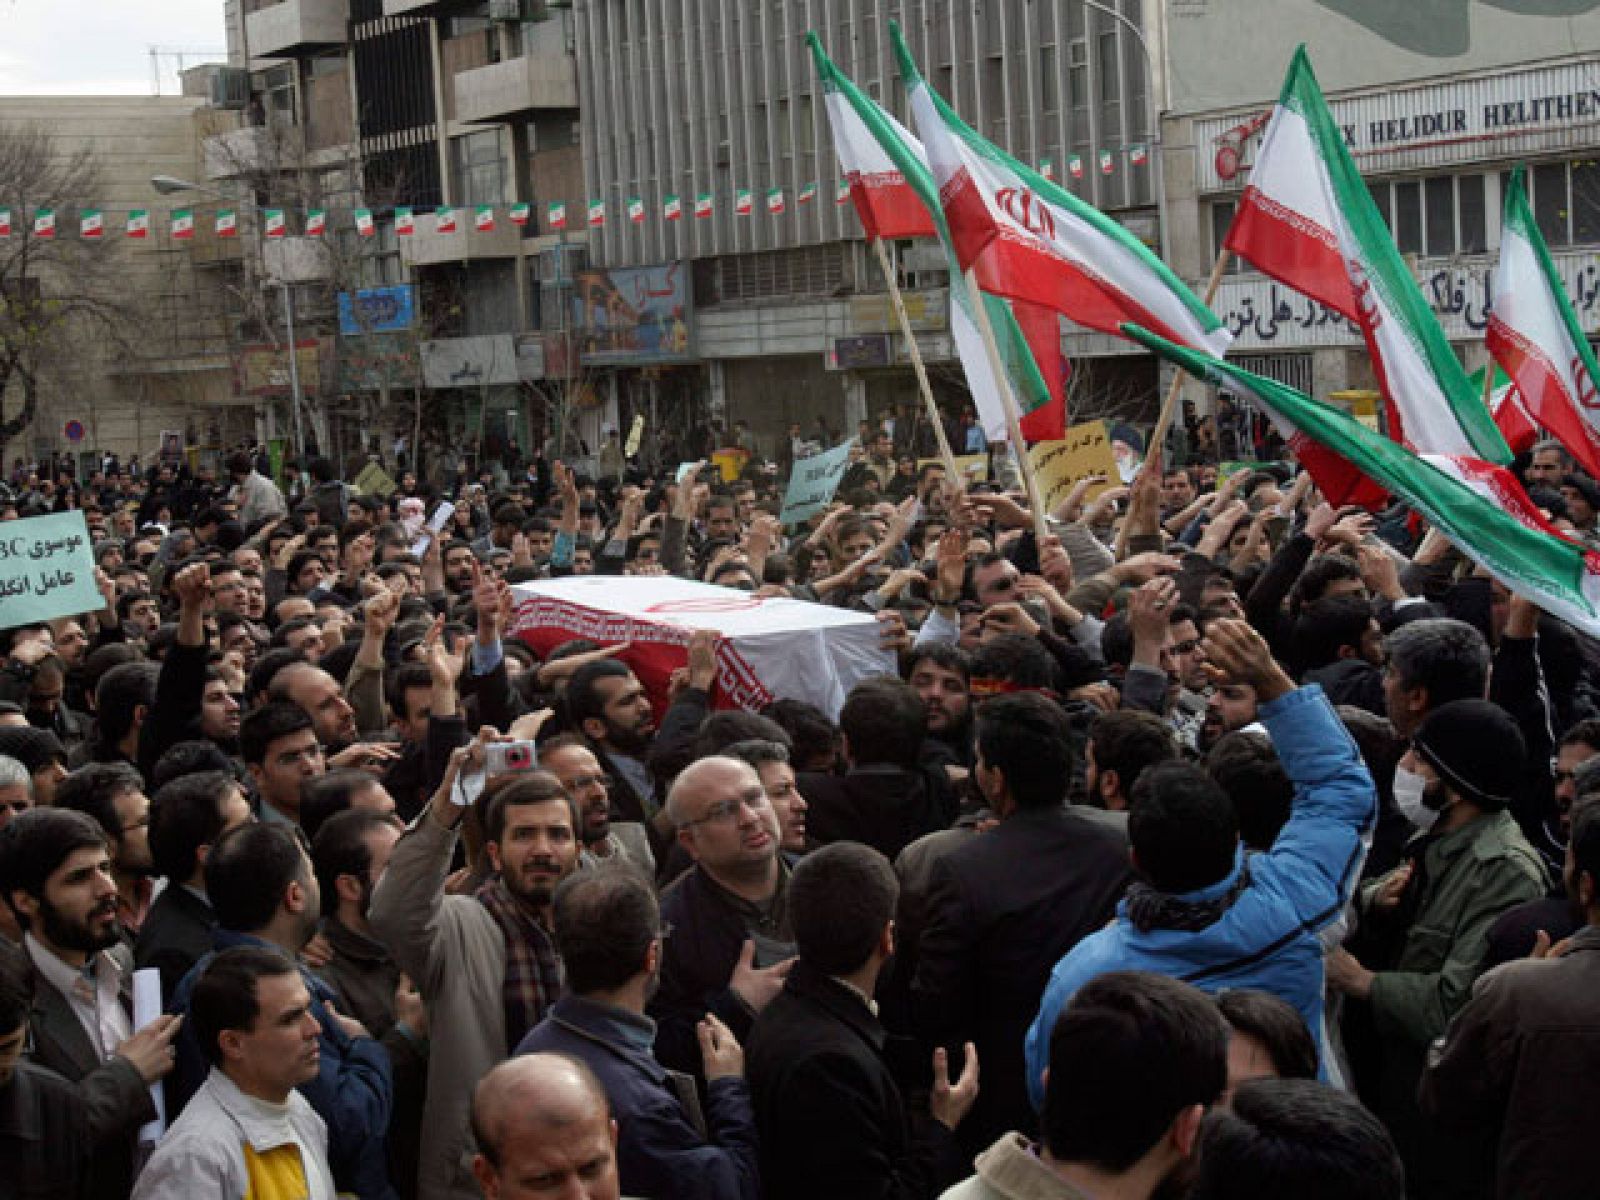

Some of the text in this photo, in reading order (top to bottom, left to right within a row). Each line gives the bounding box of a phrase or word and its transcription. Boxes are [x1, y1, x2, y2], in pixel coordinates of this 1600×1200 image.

[1369, 109, 1467, 144] HELIDUR
[28, 534, 82, 560] موسوی
[35, 569, 75, 596] عامل
